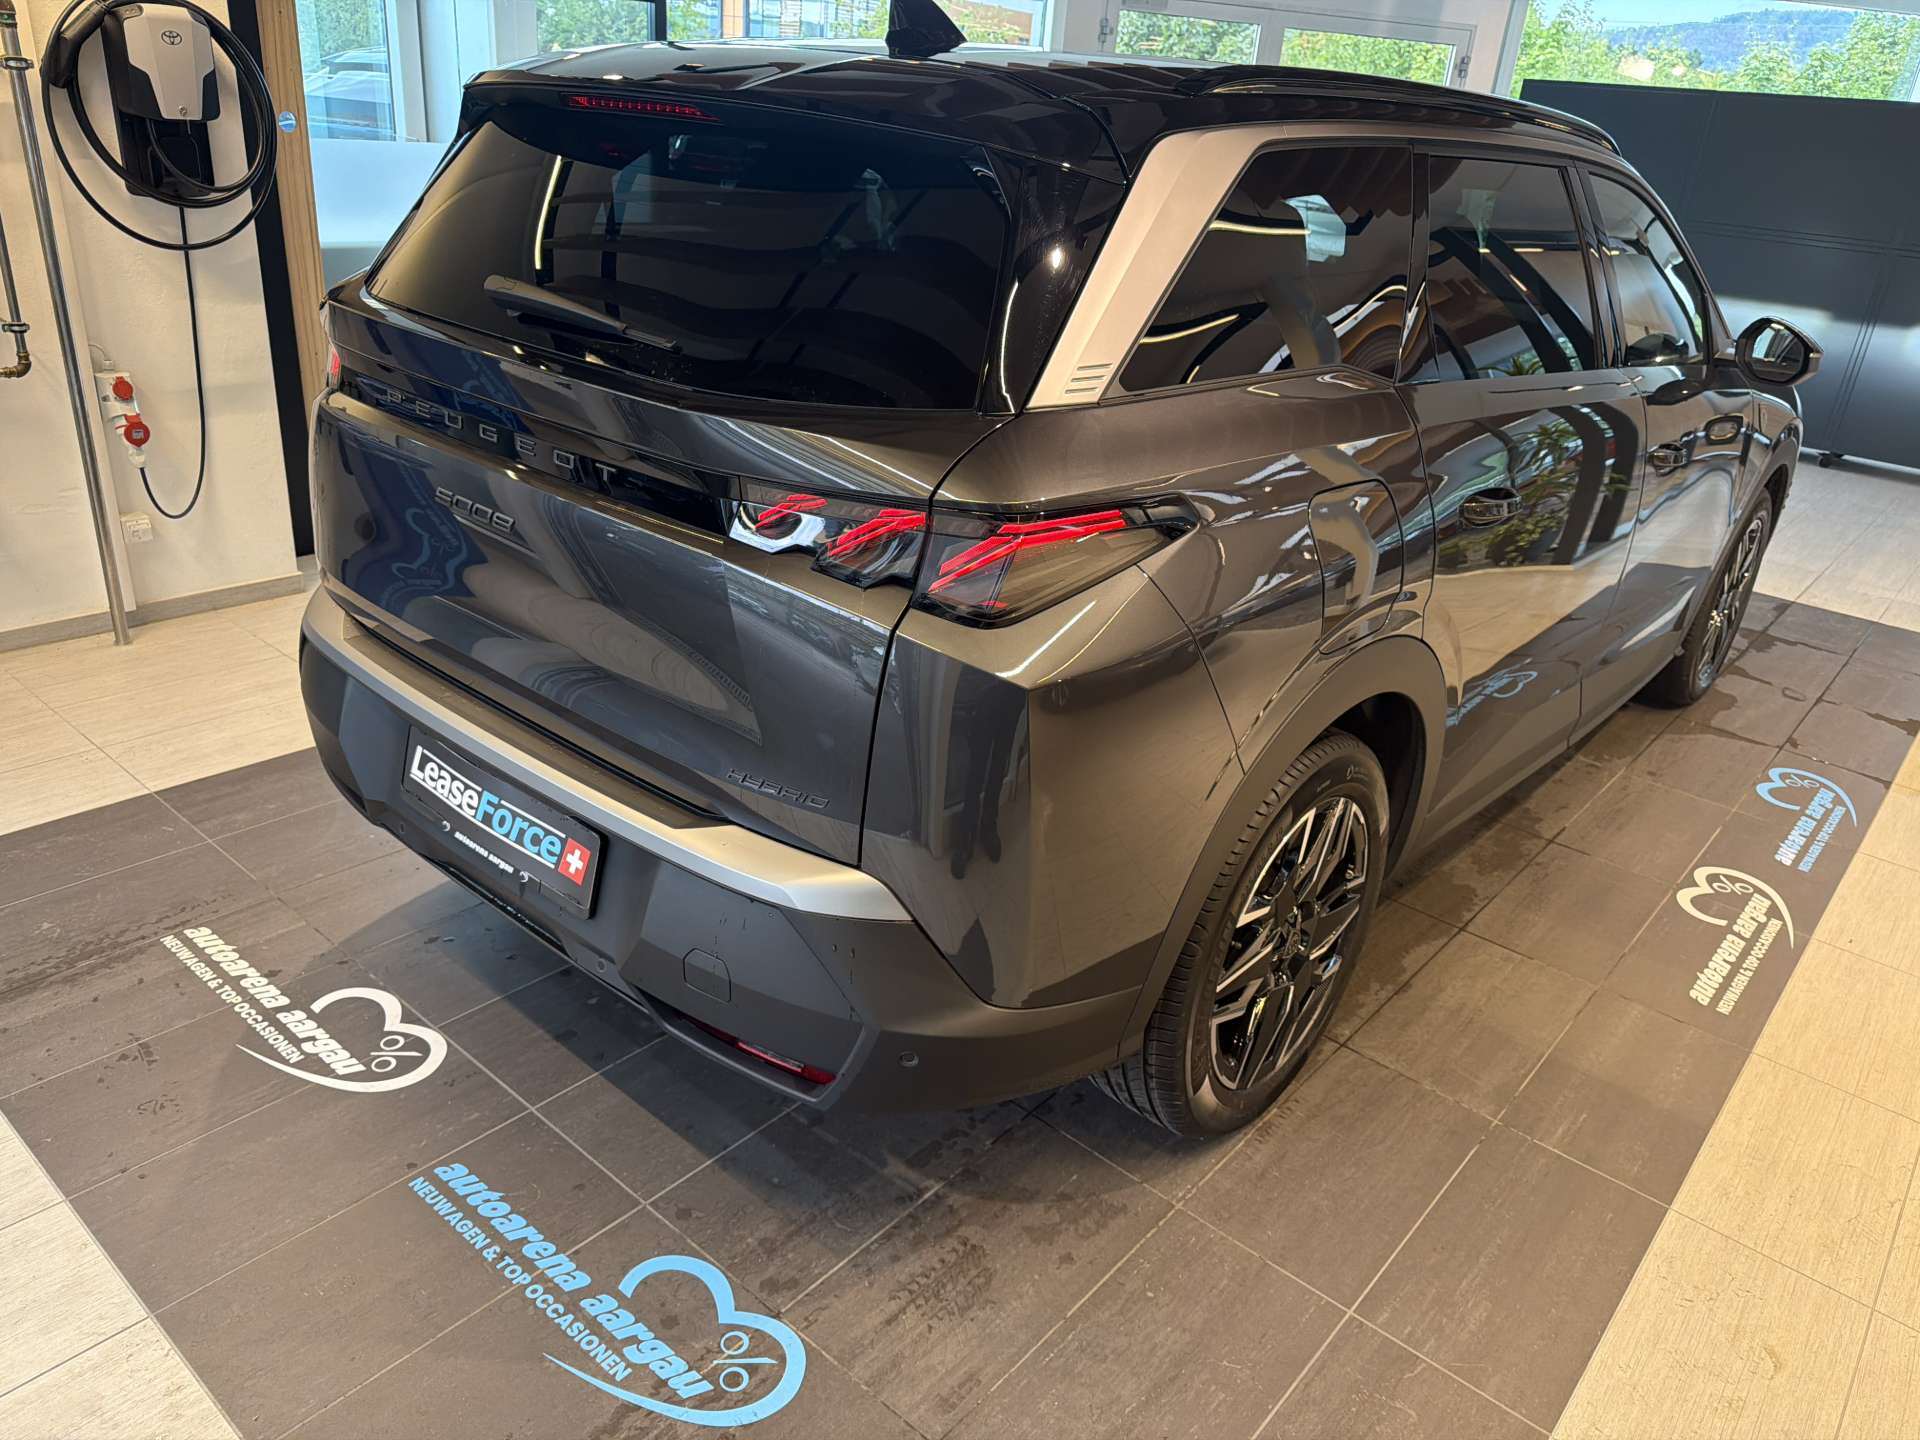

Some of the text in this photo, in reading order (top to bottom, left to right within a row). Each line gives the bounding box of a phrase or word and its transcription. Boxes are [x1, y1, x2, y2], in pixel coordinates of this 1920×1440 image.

[387, 389, 616, 482] PEUGEOT
[434, 486, 516, 533] 5008
[410, 745, 562, 864] LeaseForce
[160, 934, 304, 1064] NEUWAGEN & TOP OCCASIONEN
[183, 926, 367, 1076] autoarena aargau
[1689, 893, 1772, 1006] autoarena aargau
[408, 1176, 632, 1383] NEUWAGEN & TOP OCCASIONEN
[433, 1162, 714, 1399] autoarena aargau
